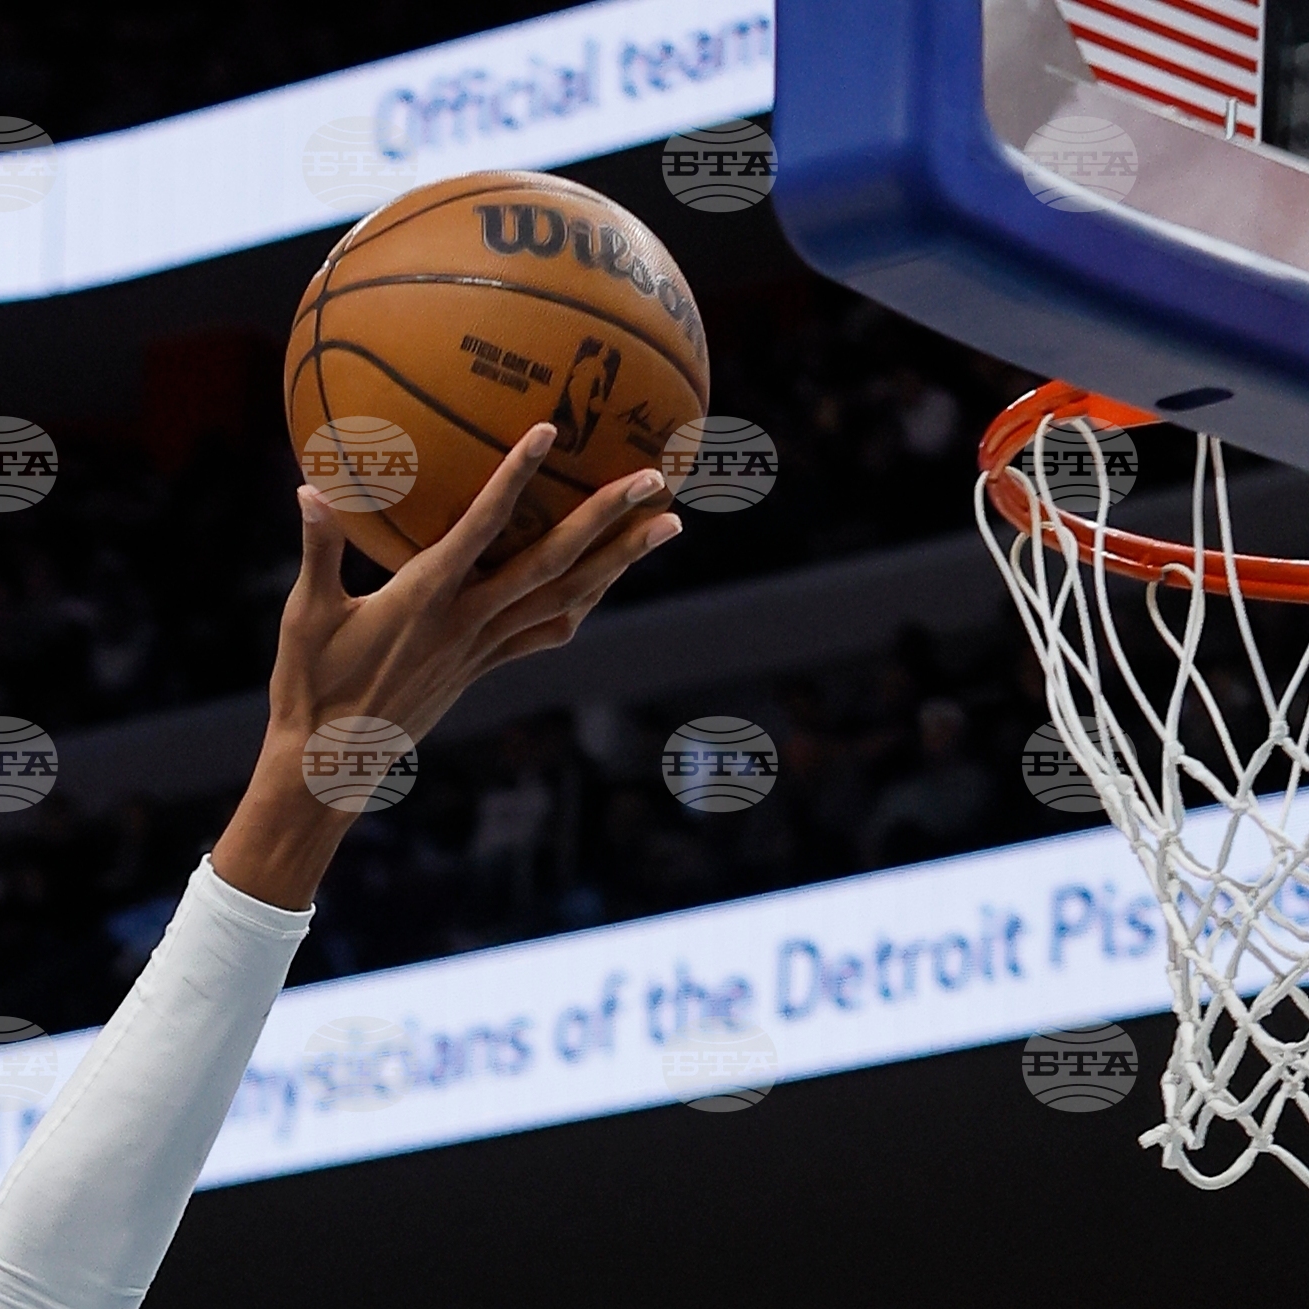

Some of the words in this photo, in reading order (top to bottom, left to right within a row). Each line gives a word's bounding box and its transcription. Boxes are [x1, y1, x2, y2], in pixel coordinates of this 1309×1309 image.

[376, 35, 600, 160] Official
[553, 968, 627, 1064] of
[773, 905, 1024, 1021] Detroit
